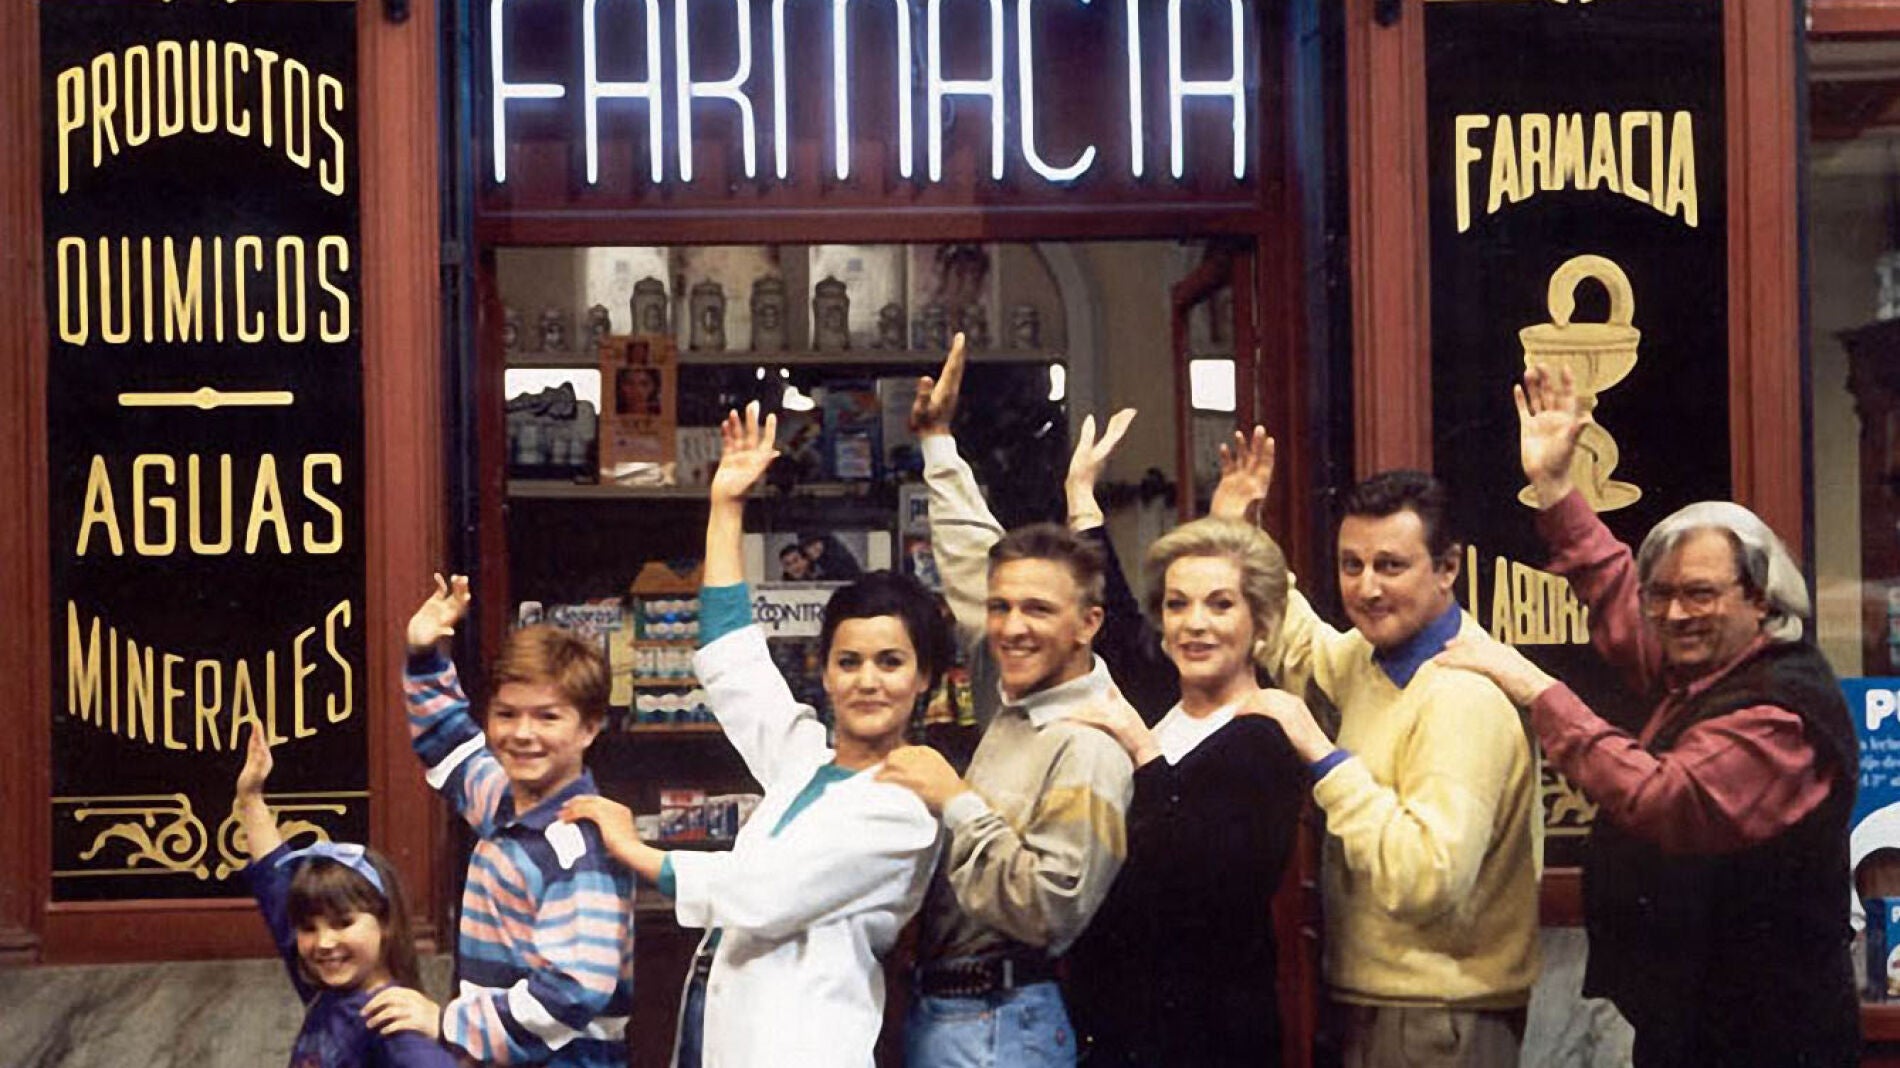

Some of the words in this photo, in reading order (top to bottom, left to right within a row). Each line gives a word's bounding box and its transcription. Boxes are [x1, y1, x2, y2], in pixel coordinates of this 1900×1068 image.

[57, 40, 344, 196] PRODUCTOS
[489, 0, 1246, 182] FARMACIA
[1455, 111, 1698, 233] FARMACIA
[57, 236, 350, 346] QUIMICOS
[76, 454, 343, 556] AGUAS
[1467, 545, 1590, 644] LABOR
[68, 600, 353, 751] MINERALES
[1866, 688, 1900, 730] P
